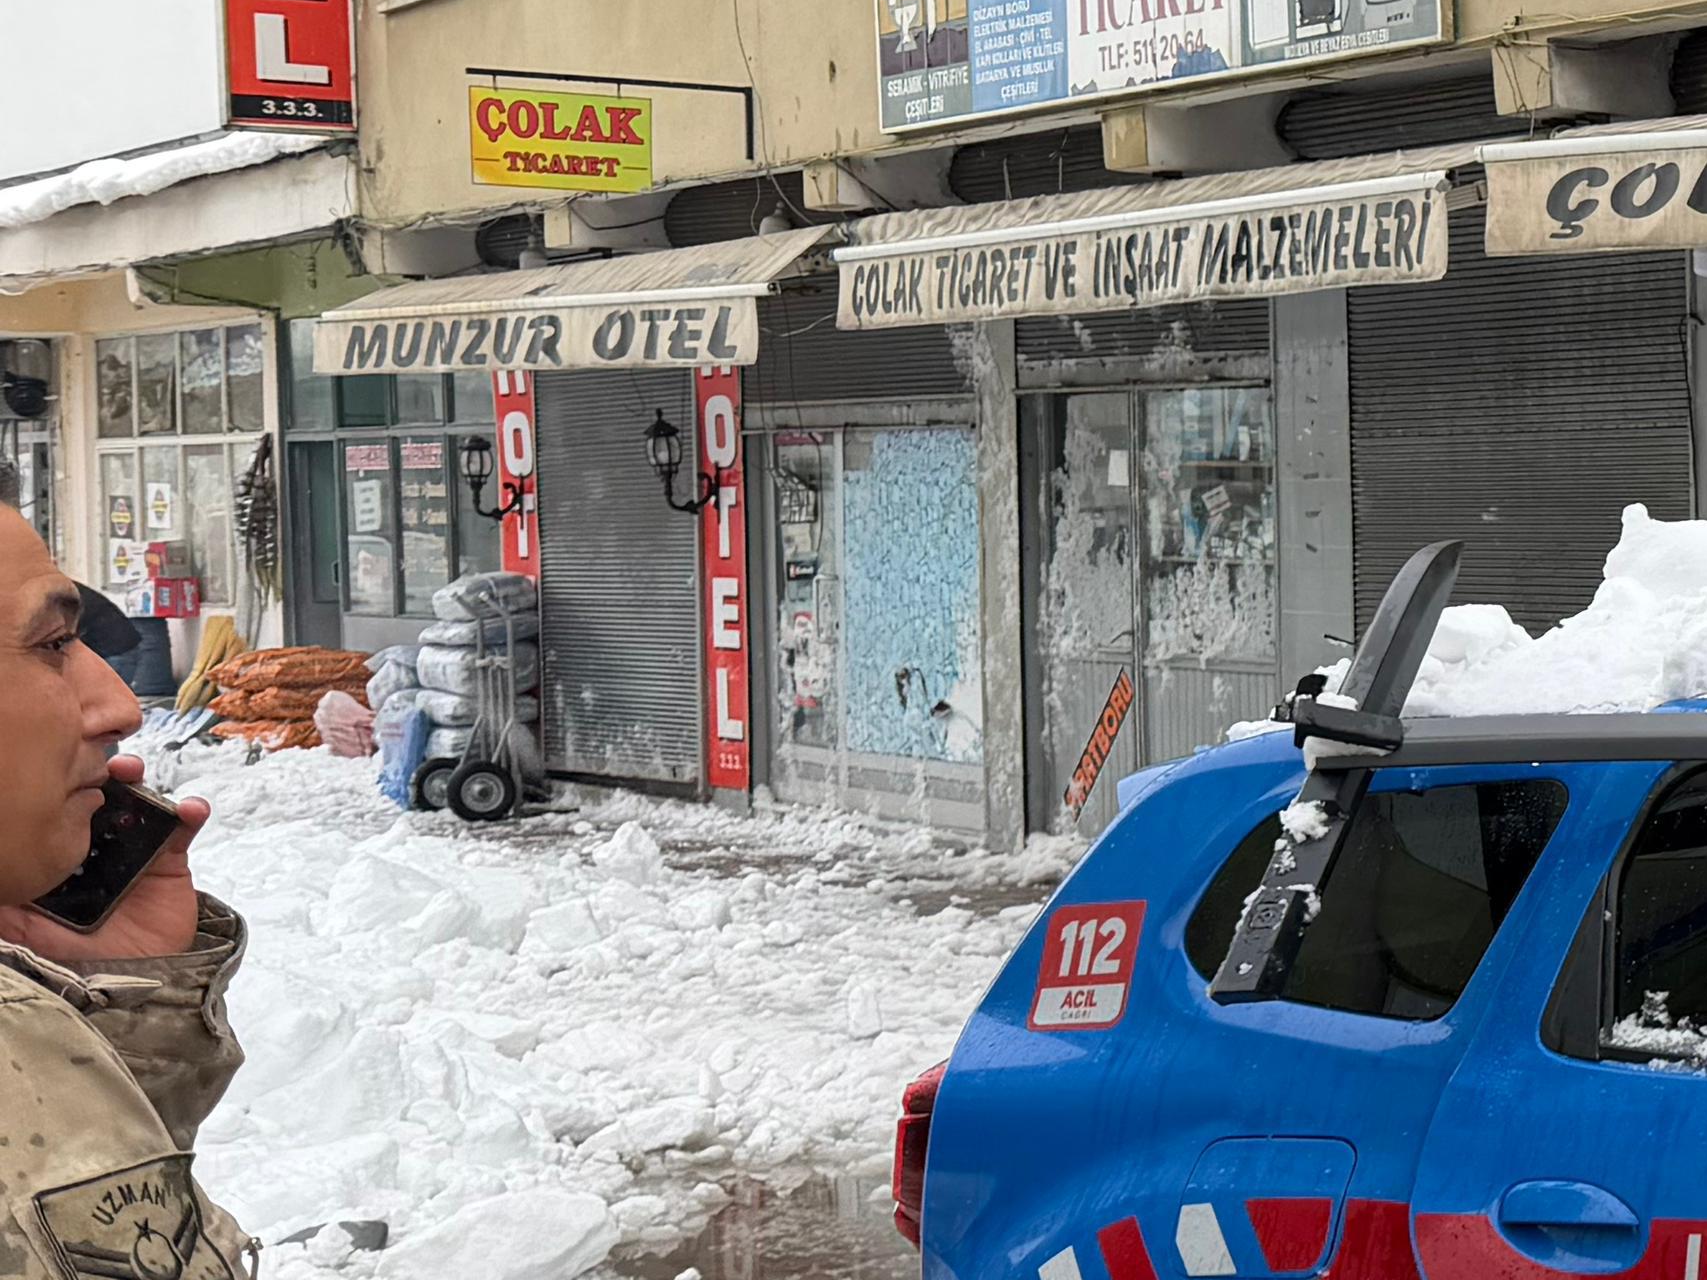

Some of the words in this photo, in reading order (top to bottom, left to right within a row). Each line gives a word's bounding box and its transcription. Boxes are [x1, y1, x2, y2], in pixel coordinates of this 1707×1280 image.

[1160, 33, 1179, 62] 20
[261, 99, 324, 118] 3.3.3.
[476, 97, 645, 146] ÇOLAK
[502, 150, 621, 178] TİCARET
[852, 257, 925, 326] ÇOLAK
[935, 244, 1038, 310] TİCARET
[1044, 239, 1078, 301] VE
[1093, 224, 1191, 307] İNŞAAT
[1198, 188, 1432, 286] MALZEMELERİ
[342, 314, 563, 369] MUNZUR
[592, 305, 739, 362] OTEL
[1058, 916, 1127, 978] 112
[92, 1181, 166, 1225] UZMAN
